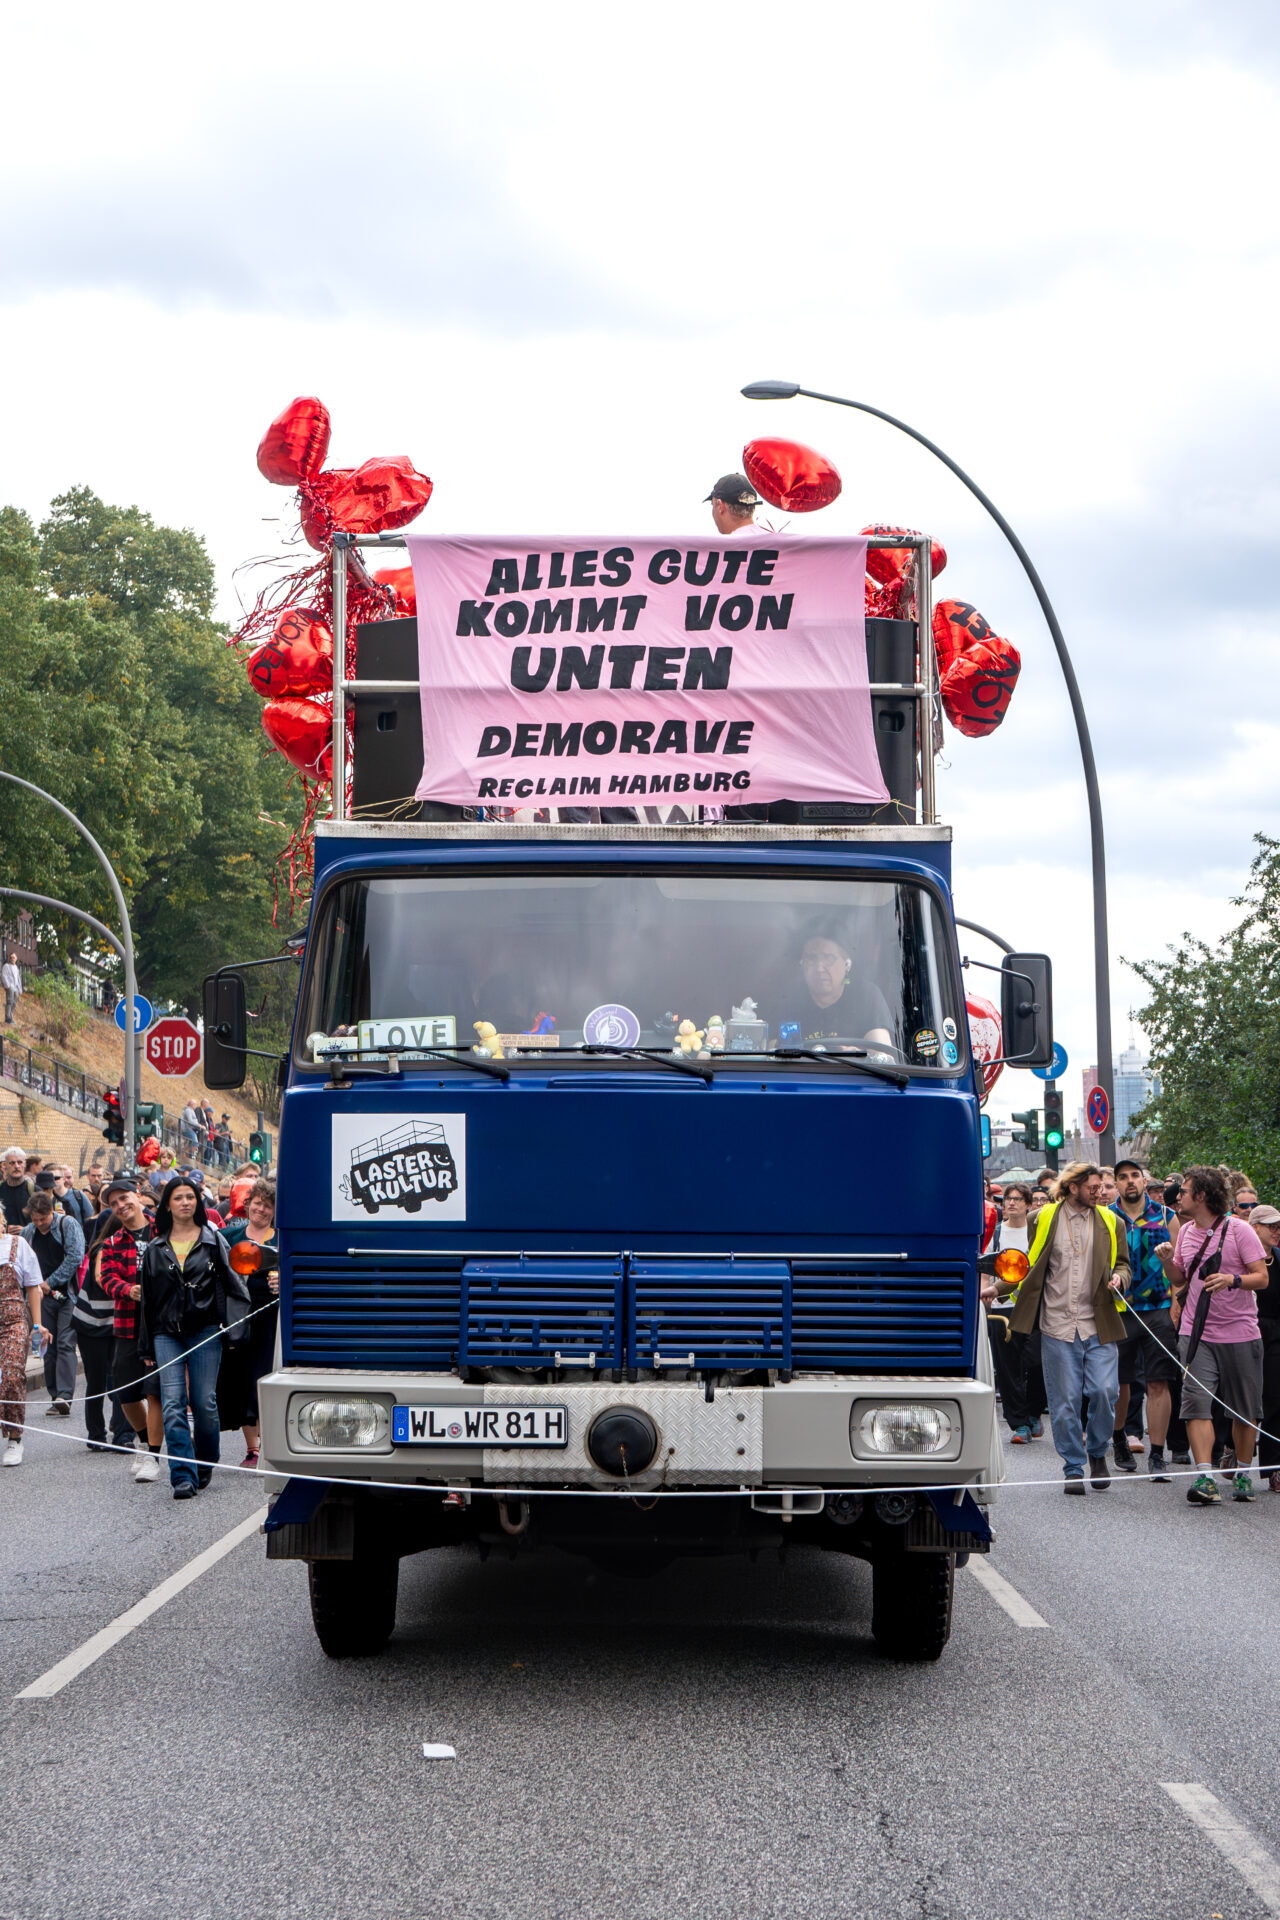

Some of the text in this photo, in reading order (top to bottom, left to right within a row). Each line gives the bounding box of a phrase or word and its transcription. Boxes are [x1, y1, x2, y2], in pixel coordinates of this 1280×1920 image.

[485, 547, 779, 596] ALLES GUTE
[456, 593, 795, 637] KOMMT VON
[511, 645, 733, 693] UNTEN
[477, 720, 754, 757] DEMORAVE
[477, 770, 751, 798] RECLAIM HAMBURG
[151, 1035, 196, 1059] STOP
[368, 1024, 447, 1048] LOVE
[354, 1150, 434, 1188] LASTER
[369, 1168, 453, 1203] KULTUR
[398, 1428, 405, 1436] D
[411, 1411, 446, 1437] WL
[465, 1411, 499, 1438] WR
